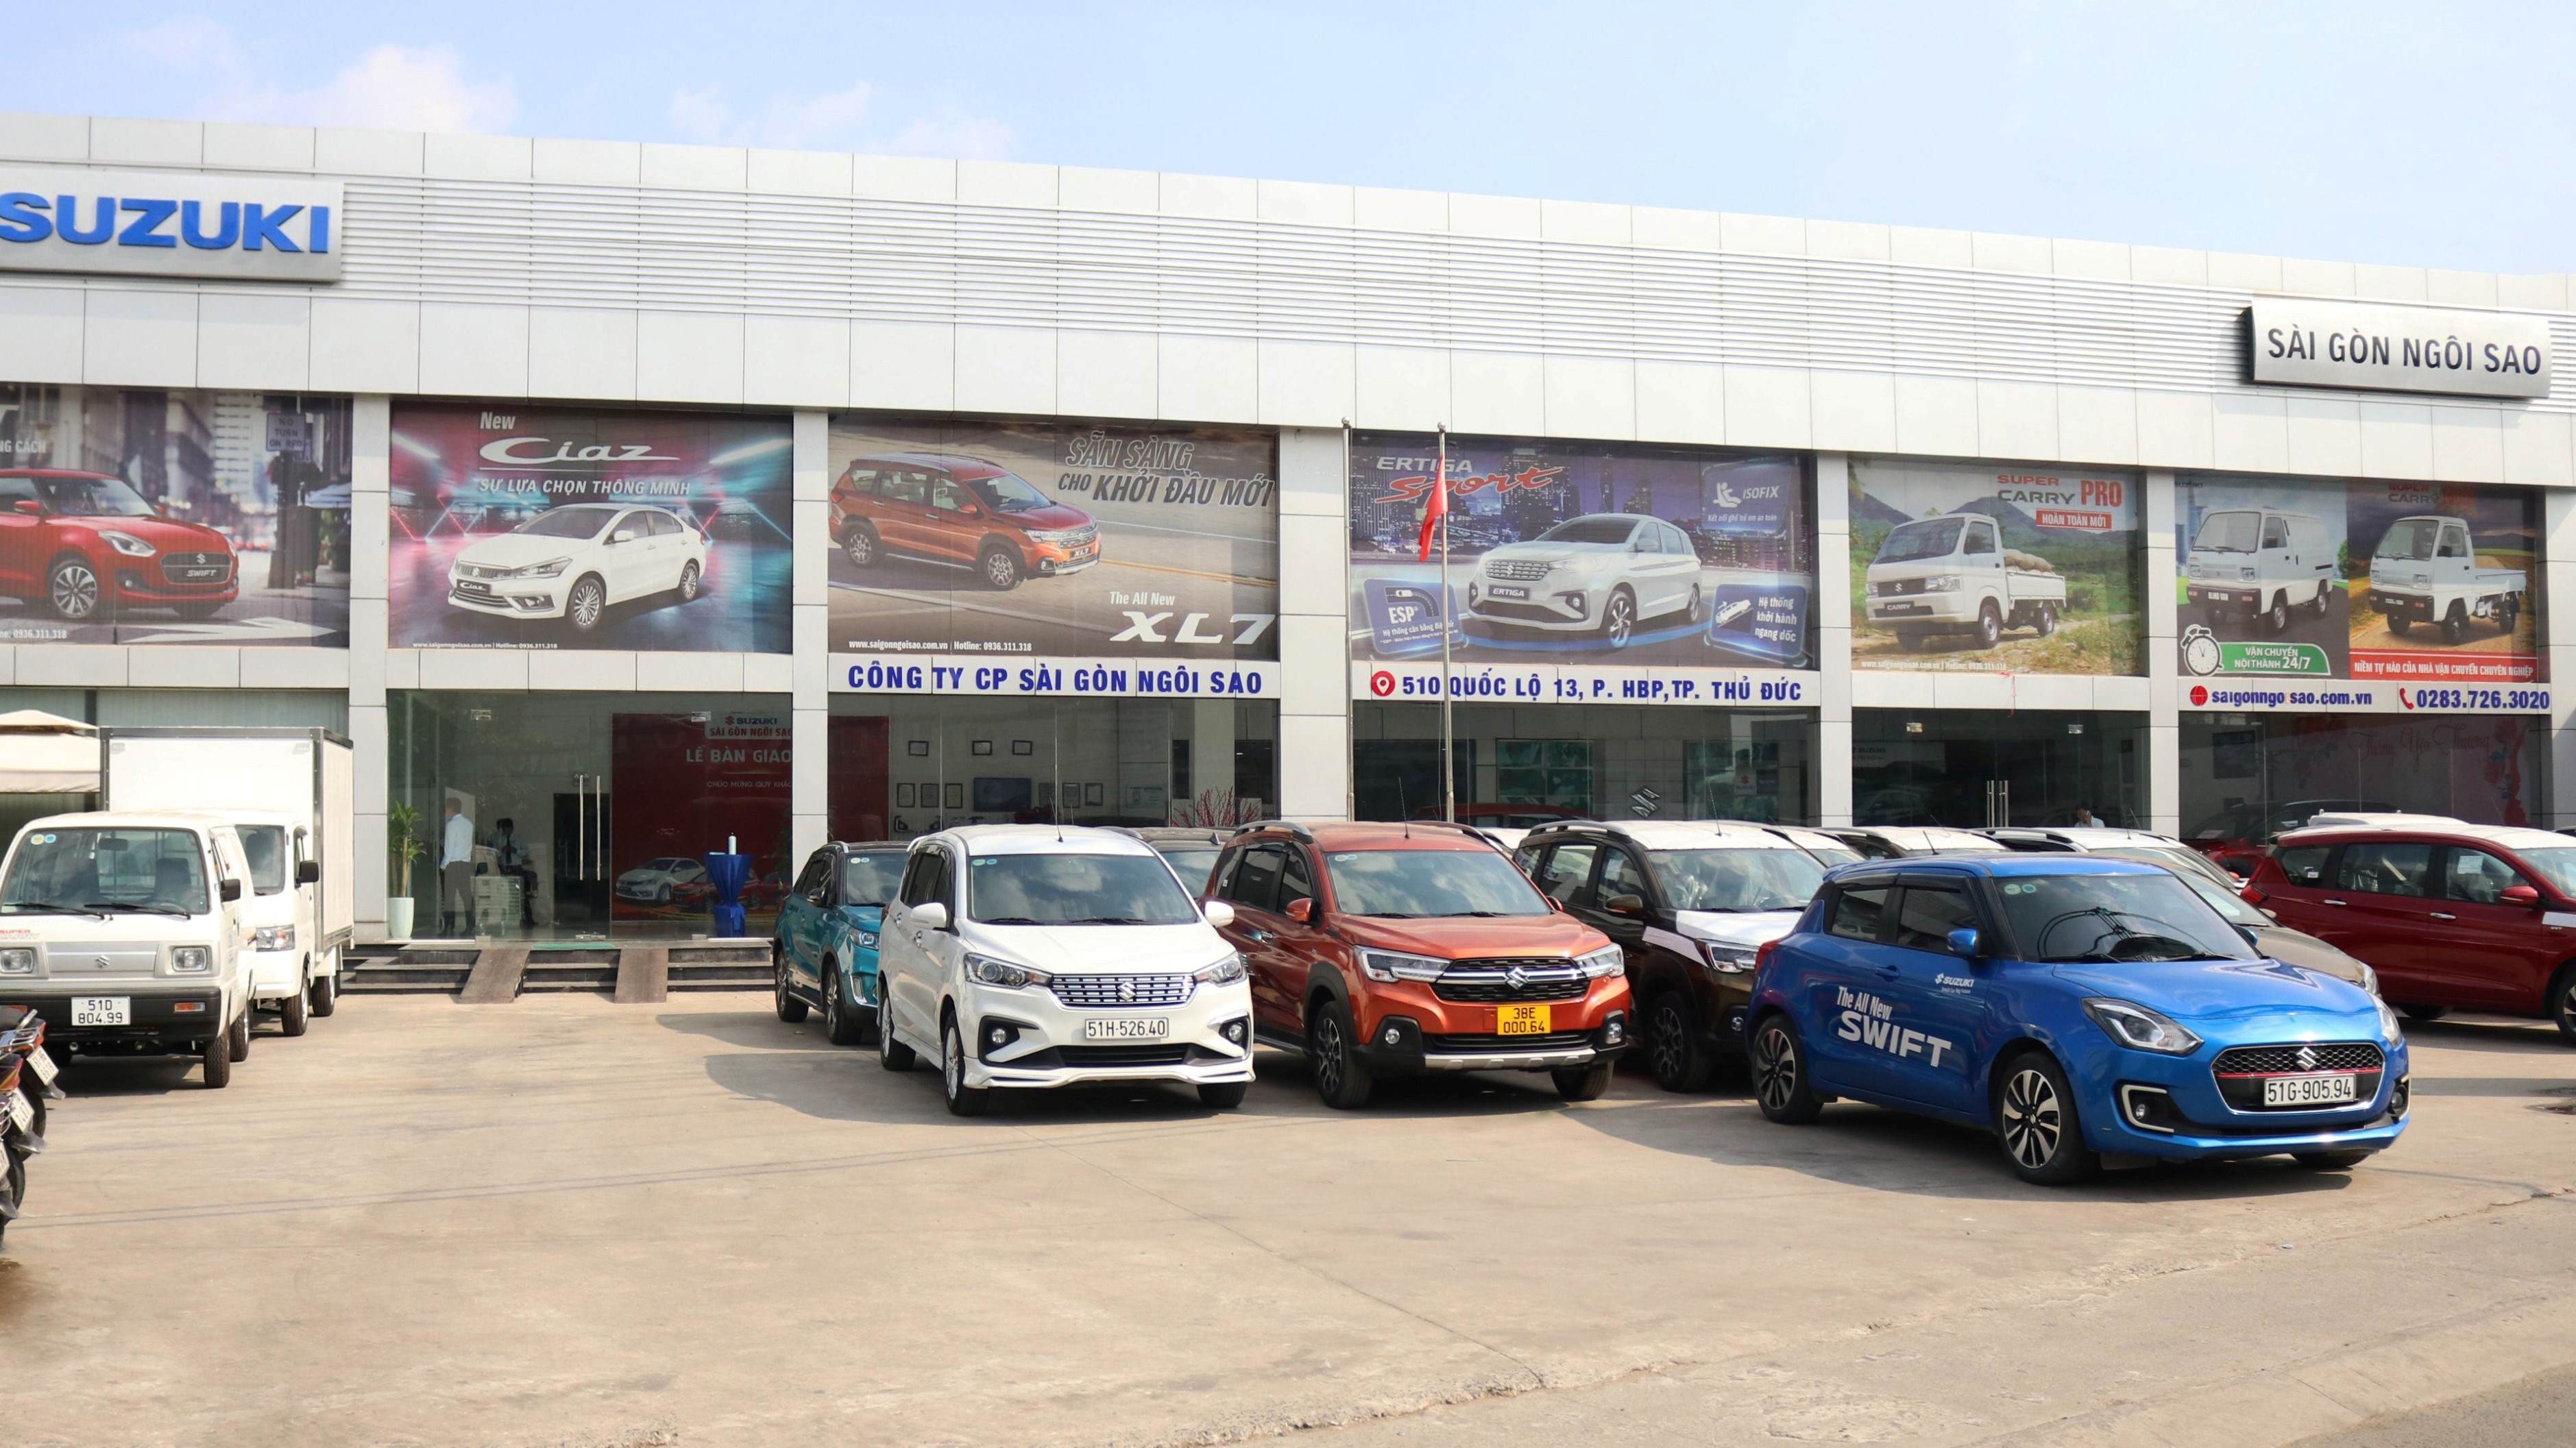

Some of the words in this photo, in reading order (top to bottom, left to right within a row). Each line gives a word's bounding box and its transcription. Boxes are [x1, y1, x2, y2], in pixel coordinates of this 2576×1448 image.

[0, 193, 329, 254] SUZUKI
[2268, 323, 2315, 360] SÀI
[2329, 328, 2390, 365] GÒN
[2403, 335, 2472, 371] NGÔI
[2484, 343, 2542, 375] SAO
[481, 412, 515, 430] New
[480, 437, 680, 465] Ciaz
[1066, 431, 1121, 467] SẴN
[1123, 436, 1194, 471] SÀNG
[481, 478, 502, 496] SỰ
[508, 478, 537, 496] LỰA
[543, 480, 586, 498] CHỌN
[593, 478, 645, 496] THÔNG
[651, 482, 690, 496] MINH
[1058, 472, 1090, 492] CHO
[1093, 469, 1158, 503] KHỞI
[1163, 470, 1216, 505] ĐẦU
[1220, 474, 1274, 507] MỚI
[1997, 474, 2059, 487] SUPER
[1742, 486, 1780, 499] ISOFIX
[1997, 489, 2076, 505] CARRY
[2081, 480, 2122, 507] PRO
[2042, 513, 2065, 526] HOÀN
[2067, 513, 2089, 526] TOÀN
[2091, 513, 2106, 527] MỚI
[1074, 548, 1091, 556] XL7
[1110, 591, 1130, 605] The
[1132, 592, 1147, 606] All
[1150, 593, 1175, 606] New
[1493, 588, 1524, 597] ERTIGA
[1758, 597, 1768, 609] Hệ
[1775, 613, 1797, 625] hành
[1110, 611, 1275, 644] XL7
[1755, 628, 1778, 641] ngang
[849, 640, 947, 650] www.saigonngoisao.com.vn
[954, 641, 982, 650] Hotline:
[984, 642, 1032, 651] 0936.311.318
[2245, 646, 2263, 657] VẬN
[2265, 646, 2298, 656] CHUYỂN
[2251, 658, 2281, 668] THÀNH
[2283, 656, 2311, 670] 24/7
[849, 661, 923, 689] CÔNG
[932, 667, 961, 690] TY
[975, 668, 1008, 690] CP
[1020, 664, 1062, 691] SÀI
[1074, 665, 1127, 692] GÒN
[1138, 665, 1199, 694] NGÔI
[1211, 671, 1262, 694] SAO
[1403, 676, 1439, 694] 510
[1450, 667, 1506, 697] QUỐC
[1516, 673, 1541, 701] LỘ
[1554, 678, 1583, 700] 13,
[1593, 679, 1613, 697] P.
[1712, 676, 1751, 700] THỦ
[1760, 676, 1801, 701] ĐỨC
[2416, 690, 2549, 709] 0283.726.3020
[686, 745, 705, 762] LỄ
[711, 746, 746, 762] BÀN
[754, 749, 791, 763] GIAO
[1943, 977, 1974, 987] SUZUKI
[88, 999, 112, 1011] 51D
[1837, 985, 1853, 1009] The
[1855, 992, 1869, 1012] All
[1870, 995, 1892, 1020] New
[78, 1012, 123, 1024] 804.99
[1513, 1007, 1535, 1020] 38E
[1088, 1020, 1165, 1038] 51H-526.40
[1503, 1021, 1545, 1033] 000.64
[1838, 1011, 1952, 1068] SWIFT
[2268, 1079, 2352, 1102] 51G-905.94
